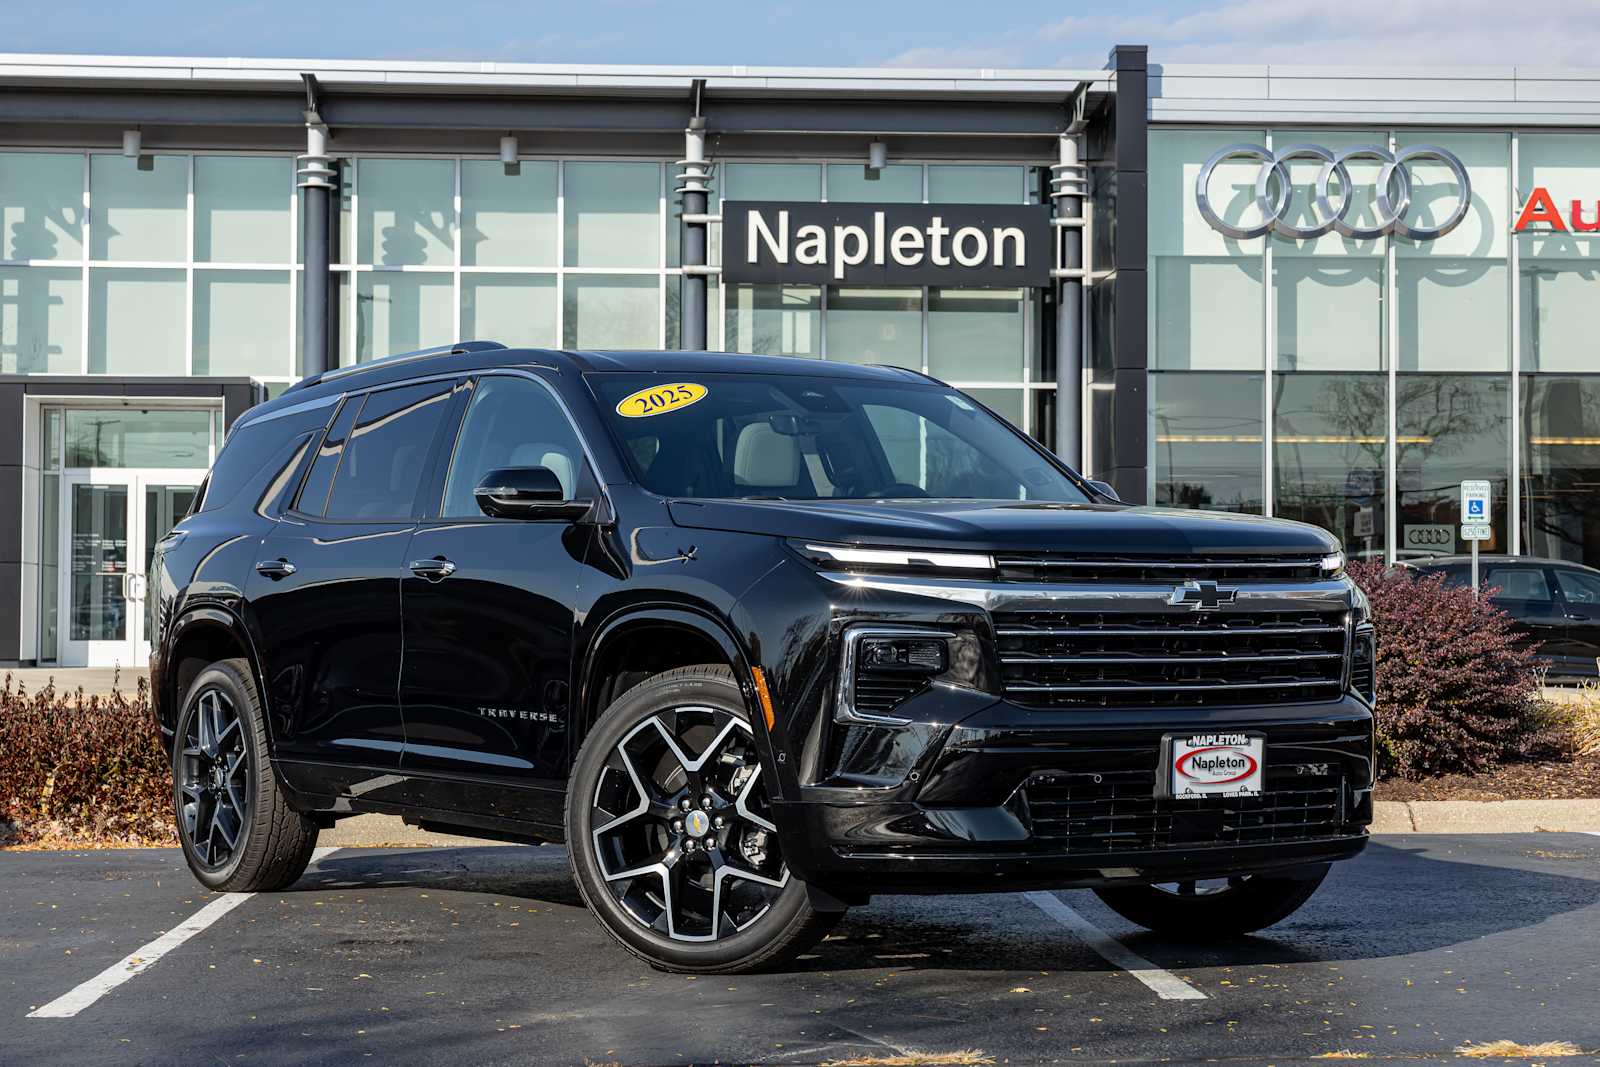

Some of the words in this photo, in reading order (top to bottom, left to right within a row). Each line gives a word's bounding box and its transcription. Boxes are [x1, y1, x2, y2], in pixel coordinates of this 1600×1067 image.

[1515, 187, 1600, 231] Au
[747, 209, 1026, 280] Napleton
[635, 385, 693, 413] 2025
[478, 707, 557, 722] TRAVERSE
[1192, 734, 1245, 745] NAPLETON
[1192, 756, 1245, 771] Napleton
